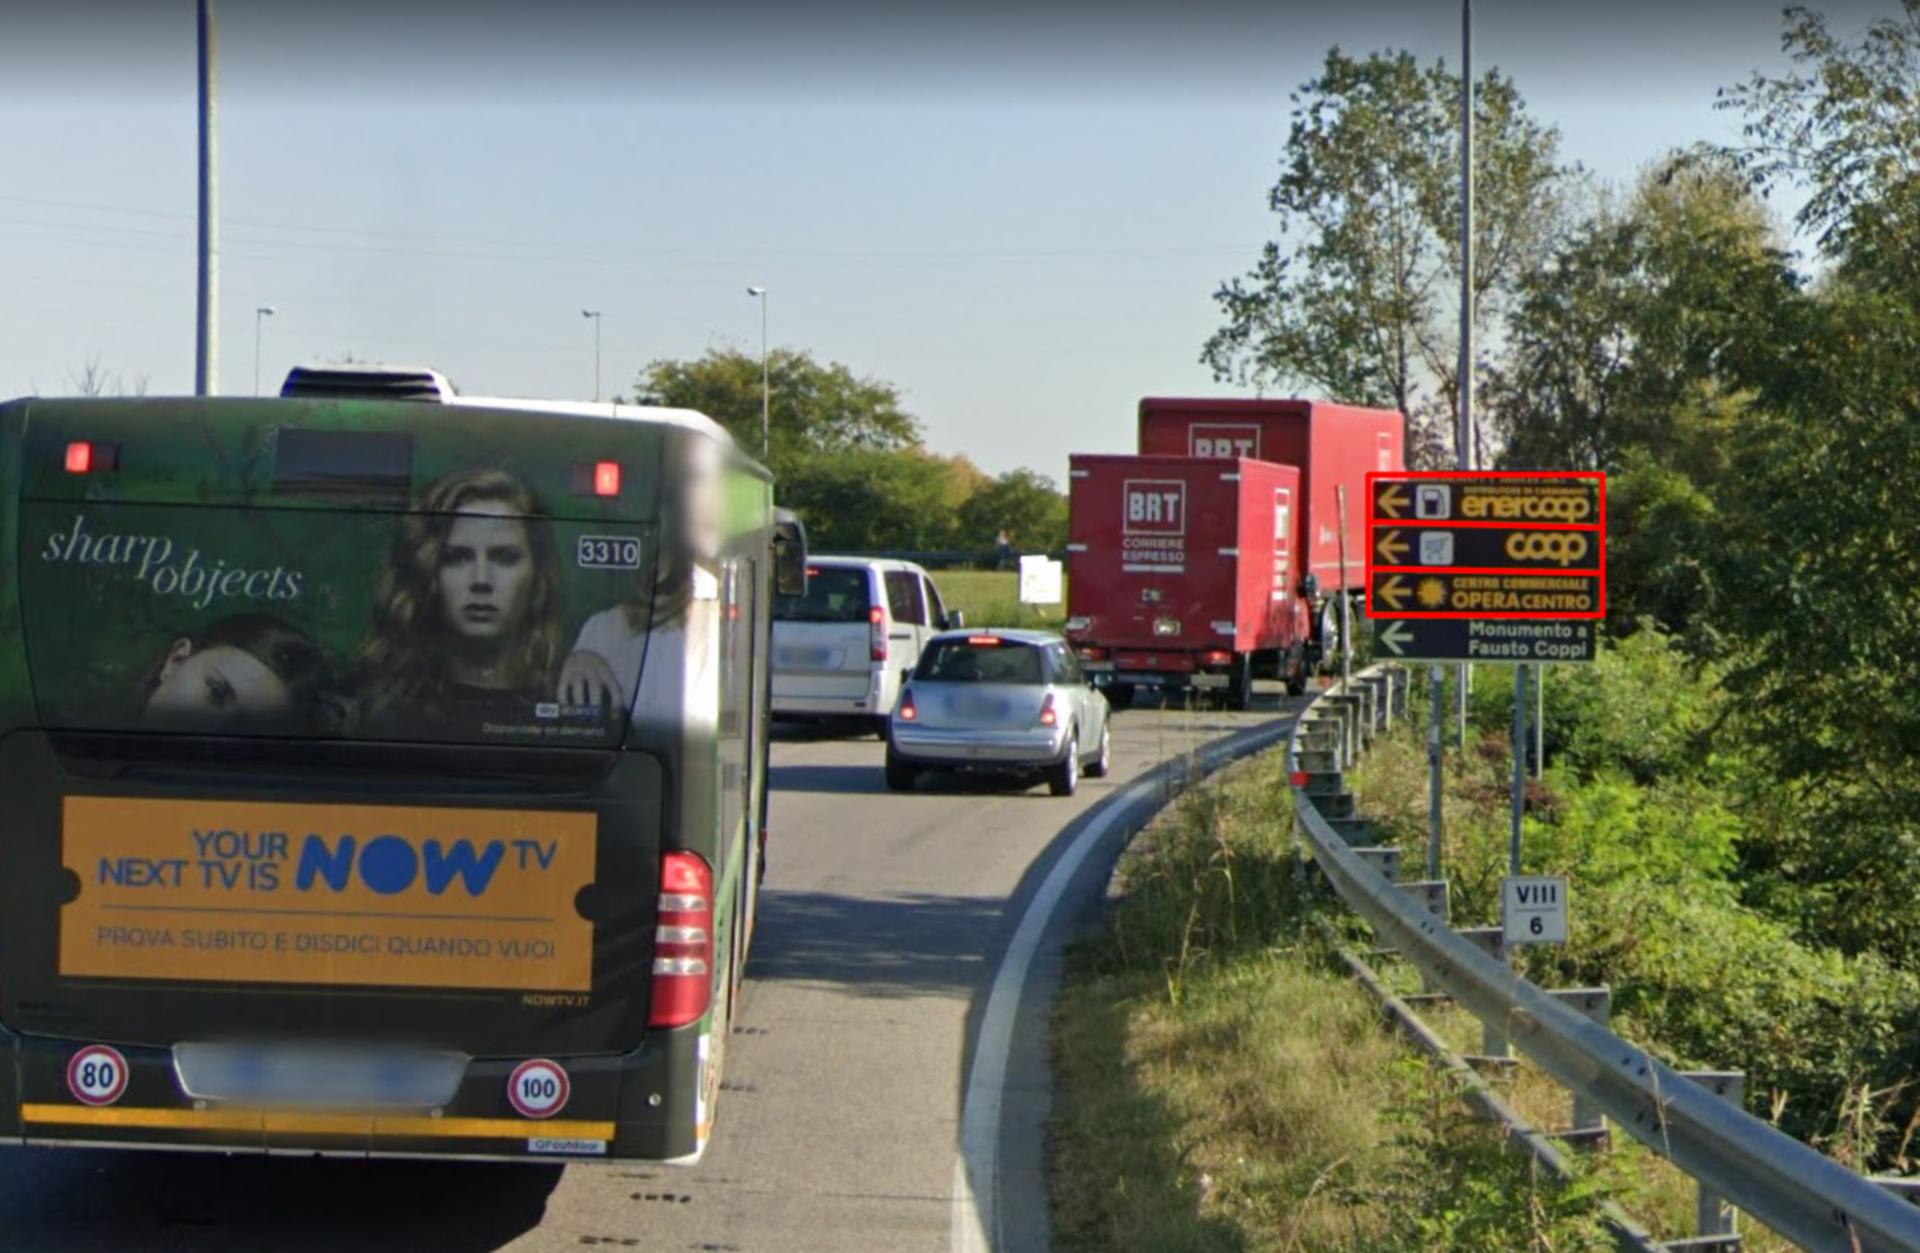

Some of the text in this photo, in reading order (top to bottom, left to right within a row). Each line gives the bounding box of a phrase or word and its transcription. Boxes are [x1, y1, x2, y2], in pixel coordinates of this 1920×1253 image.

[1128, 492, 1180, 523] BRT
[1461, 494, 1590, 523] enercoop
[42, 514, 172, 580] sharp
[580, 540, 638, 564] 3310
[1122, 537, 1185, 549] CORRIERE
[1506, 532, 1588, 567] coop
[1122, 551, 1185, 562] ESPRESSO
[152, 549, 303, 610] objects
[1453, 577, 1499, 589] CENTRO
[1468, 621, 1588, 638] Monumento a
[1468, 640, 1588, 659] Fausto Coppi
[191, 829, 289, 860] YOUR
[97, 856, 279, 892] NEXT TV IS
[294, 834, 557, 897] NOW TV
[1516, 885, 1556, 904] VIII
[1530, 916, 1543, 935] 6
[97, 926, 555, 959] PROVA SUBITO E DISDICI QUANDO VUOI
[82, 1062, 114, 1088] 80
[522, 1077, 556, 1099] 100
